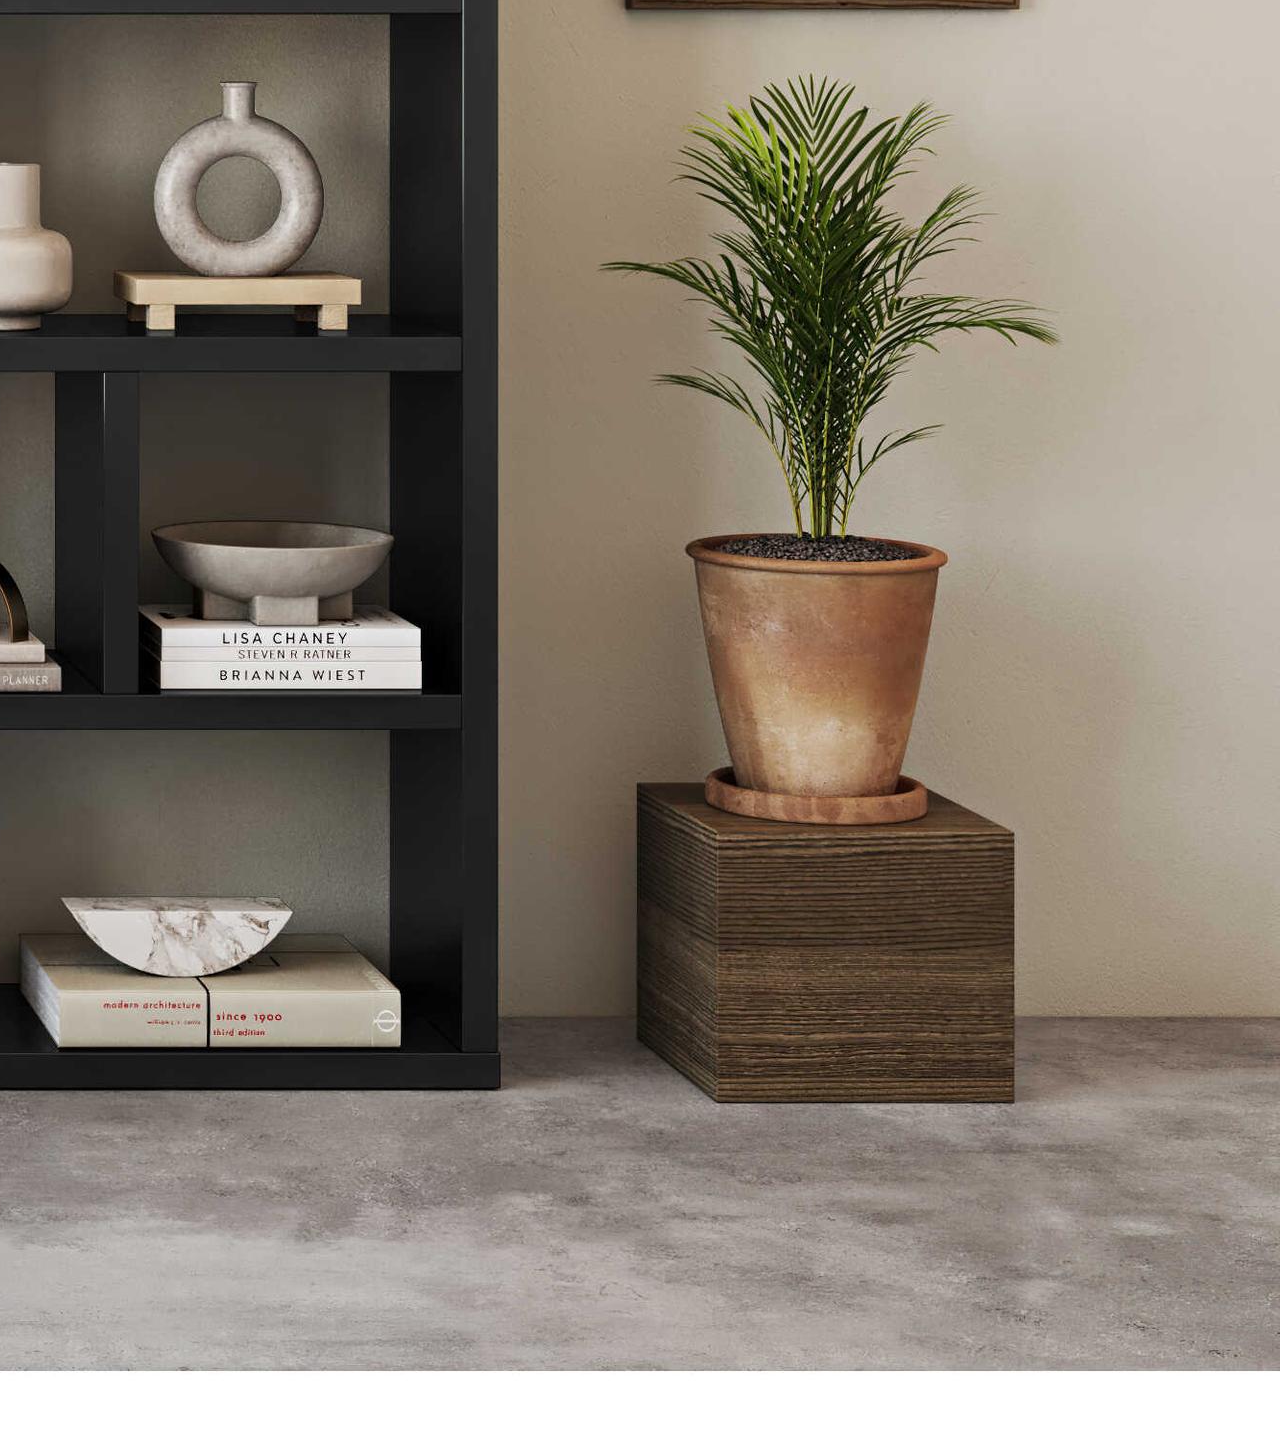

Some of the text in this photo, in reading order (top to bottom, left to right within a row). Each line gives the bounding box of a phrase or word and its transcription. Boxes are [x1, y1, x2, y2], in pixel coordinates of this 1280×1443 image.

[222, 632, 349, 644] LISA CHANEY
[238, 649, 352, 659] STEVEN R RATNER
[3, 675, 49, 685] PLANNER
[220, 669, 366, 681] BRIANNA WIEST
[104, 1001, 201, 1010] modern architecture
[216, 1011, 283, 1024] since 1900
[213, 1028, 234, 1037] third
